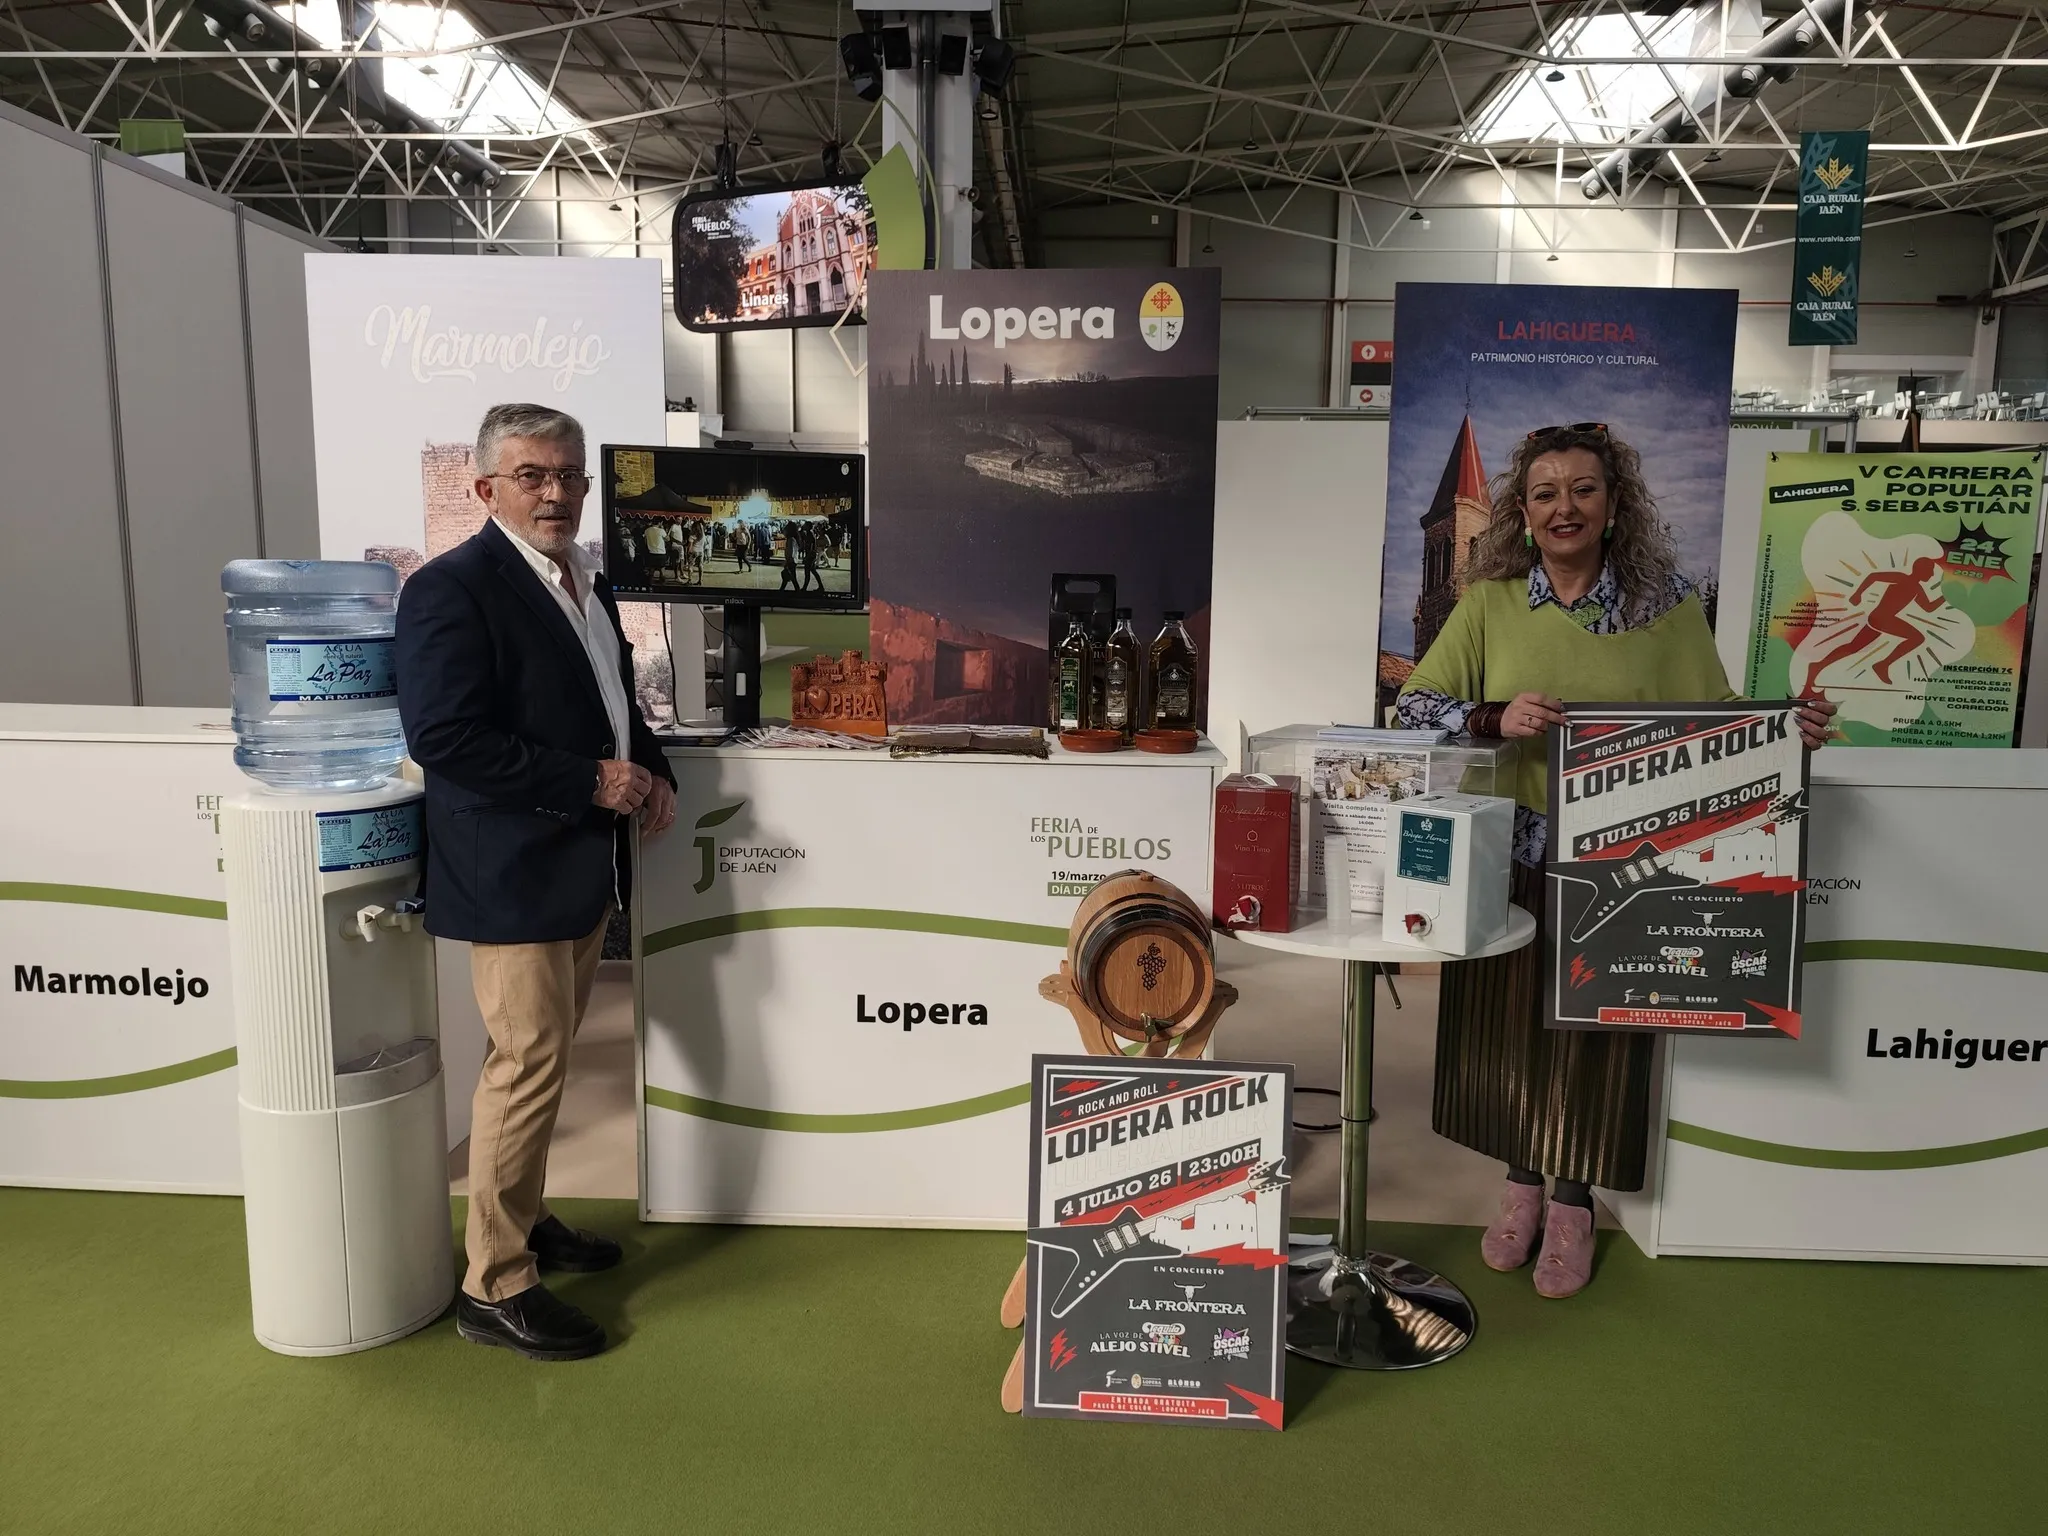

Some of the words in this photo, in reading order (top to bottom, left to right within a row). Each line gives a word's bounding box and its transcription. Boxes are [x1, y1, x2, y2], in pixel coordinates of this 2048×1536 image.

[1803, 195, 1826, 203] CAJA
[1828, 194, 1860, 203] RURAL
[1819, 205, 1843, 215] JAÉN
[696, 220, 731, 232] PUEBLOS
[742, 292, 789, 307] Linares
[1796, 302, 1819, 311] CAJA
[1821, 301, 1854, 310] RURAL
[929, 295, 1115, 348] Lopera
[1812, 312, 1836, 322] JAÉN
[1498, 320, 1636, 342] LAHIGUERA
[364, 304, 611, 392] Marmolejo
[1471, 352, 1536, 363] PATRIMONIO
[1538, 352, 1594, 364] HISTÓRICO
[1597, 354, 1604, 364] Y
[1606, 355, 1659, 365] CULTURAL
[1858, 465, 1879, 479] V
[1883, 466, 2035, 480] CARRERA
[1774, 484, 1849, 499] LAHIGUERA
[1885, 482, 2033, 497] POPULAR
[1840, 499, 1860, 512] S.
[1865, 498, 2031, 514] SEBASTIÁN
[1960, 538, 1995, 553] 24
[1946, 551, 2002, 569] ENE
[1953, 570, 1983, 578] 2026
[324, 644, 363, 652] AGUA
[307, 663, 337, 682] La
[339, 662, 373, 685] Paz
[1943, 664, 1999, 673] INSCRIPCIÓN
[1945, 678, 2000, 686] MIÉRCOLES
[1946, 703, 2009, 712] CORREDOR
[1892, 727, 1925, 735] PRUEBA
[1941, 731, 1978, 739] MARCHA
[1595, 739, 1623, 758] ROCK
[1626, 734, 1647, 749] AND
[1651, 725, 1677, 742] ROLL
[1565, 744, 1693, 804] LOPERA
[1701, 710, 1789, 765] ROCK
[1345, 804, 1378, 812] completa
[1580, 837, 1592, 851] 4
[1596, 817, 1661, 851] JULIO
[1667, 805, 1691, 825] 26
[1708, 777, 1779, 812] 23:00H
[1031, 817, 1082, 833] FERIA
[1087, 826, 1098, 834] DE
[356, 831, 383, 850] La
[385, 827, 412, 847] Paz
[720, 847, 806, 859] DIPUTACIÓN
[1048, 836, 1171, 860] PUEBLOS
[1234, 844, 1250, 852] Vino
[1252, 845, 1270, 853] Tinto
[720, 862, 738, 873] DE
[741, 861, 777, 873] JAÉN
[1052, 871, 1106, 880] 19/marzo
[1052, 884, 1071, 895] DÍA
[1073, 885, 1088, 895] DE
[1646, 925, 1670, 935] LA
[1673, 926, 1765, 937] FRONTERA
[1609, 963, 1655, 973] ALEJO
[1657, 963, 1708, 977] STIVEL
[1742, 965, 1767, 974] PABLOS
[14, 965, 209, 1005] Marmolejo
[857, 994, 988, 1031] Lopera
[1078, 1097, 1105, 1116] ROCK
[1108, 1091, 1129, 1107] AND
[1133, 1083, 1159, 1100] ROLL
[1048, 1103, 1174, 1165] LOPERA
[1182, 1073, 1269, 1125] ROCK
[1061, 1200, 1073, 1216] 4
[1078, 1180, 1142, 1216] JULIO
[1148, 1170, 1171, 1190] 26
[1188, 1142, 1260, 1177] 23:00H
[1169, 1266, 1224, 1275] CONCIERTO
[1128, 1298, 1151, 1310] LA
[1155, 1299, 1246, 1315] FRONTERA
[1090, 1341, 1137, 1353] ALEJO
[1140, 1341, 1191, 1358] STIVEL
[1224, 1345, 1250, 1354] PABLOS
[1111, 1396, 1149, 1405] ENTRADA
[1154, 1398, 1196, 1407] GRATUITA
